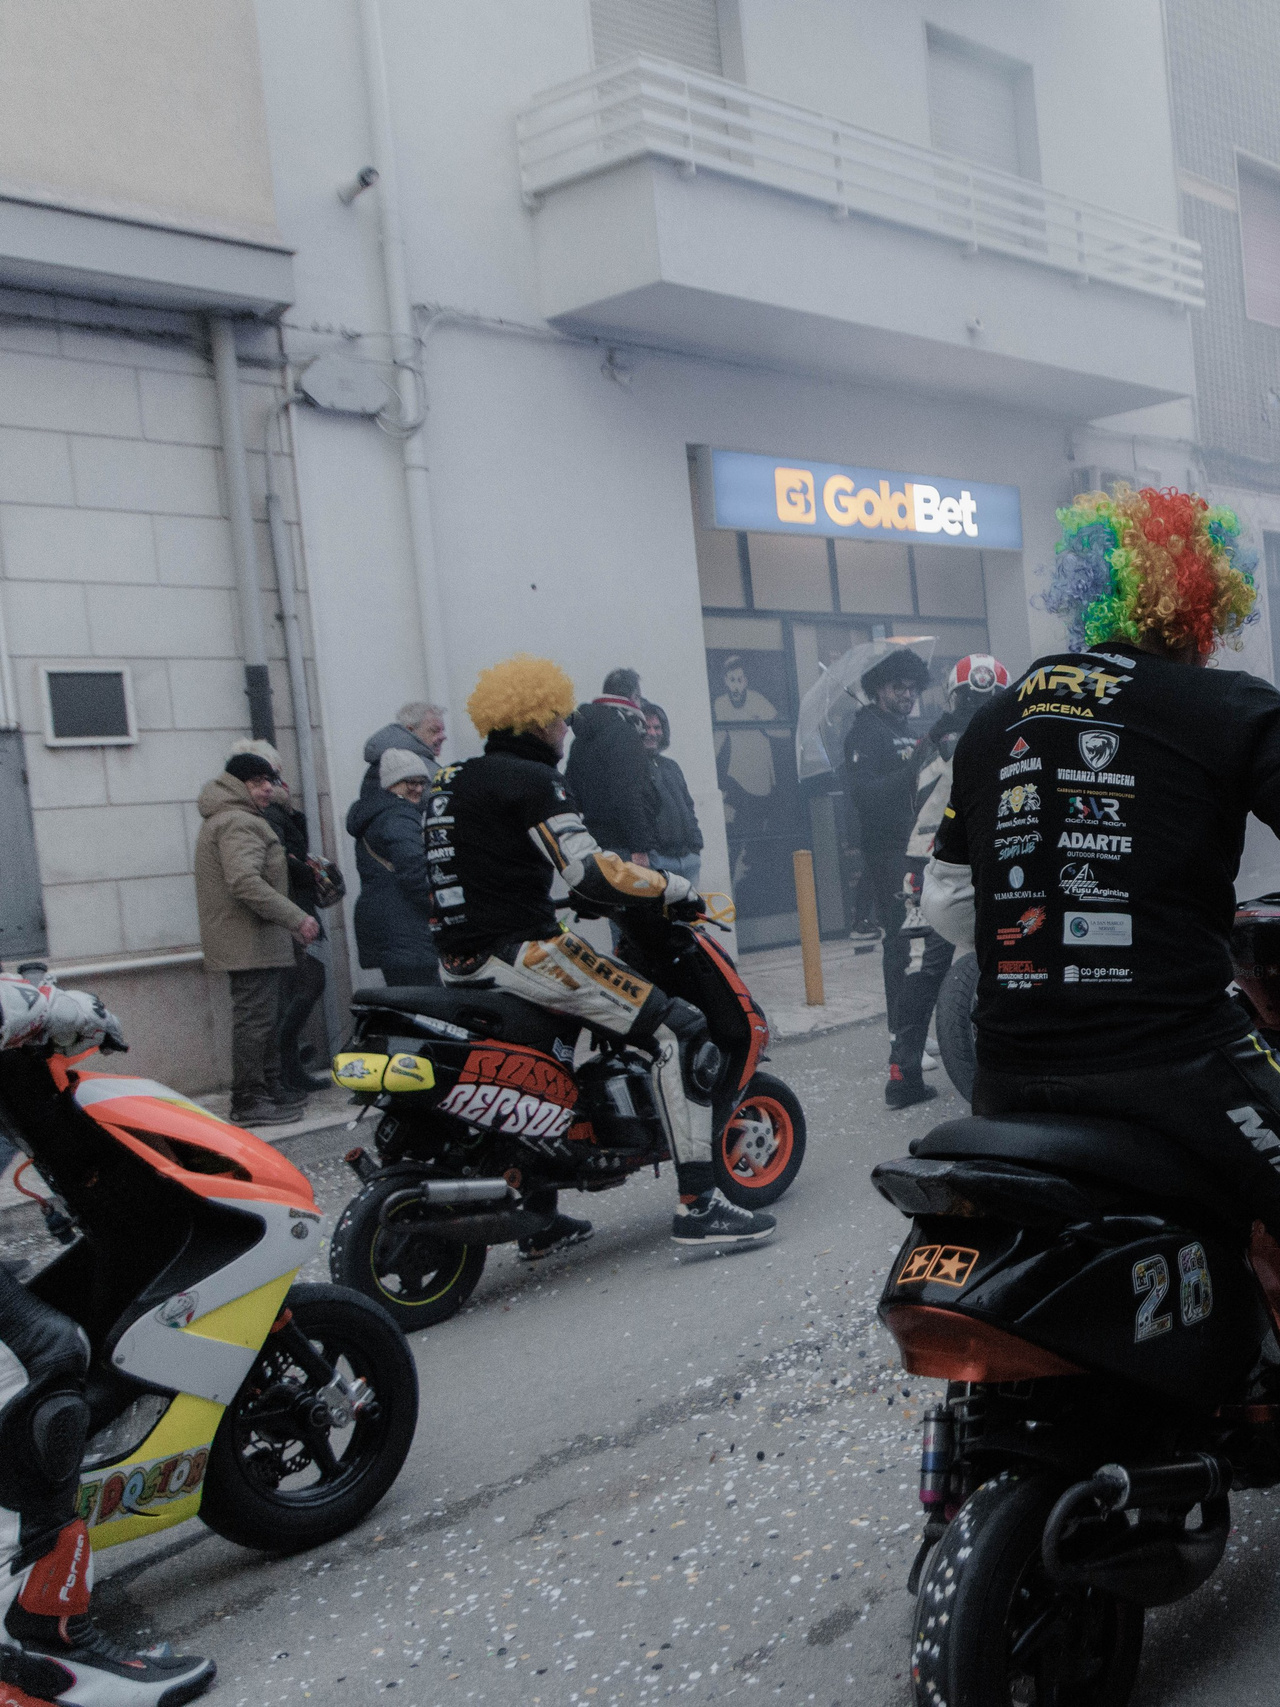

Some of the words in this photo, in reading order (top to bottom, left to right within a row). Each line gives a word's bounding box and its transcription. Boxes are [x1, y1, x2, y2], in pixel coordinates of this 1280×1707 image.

[823, 474, 979, 537] GoldBet
[1017, 664, 1122, 702] MRT
[1021, 702, 1095, 718] APRICENA
[999, 761, 1021, 781] GRUPPO
[1020, 757, 1043, 774] PALMA
[1057, 768, 1096, 783] VIGILANZA
[1097, 772, 1136, 787] APRICENA
[1057, 831, 1133, 853] ADARTE
[1066, 850, 1096, 858] OUTDOOR
[1096, 852, 1121, 861] FORMAT
[1071, 886, 1092, 894] Fusu
[1092, 887, 1129, 898] Argintina
[1131, 1241, 1214, 1344] 28
[95, 1447, 210, 1526] DOCTOR
